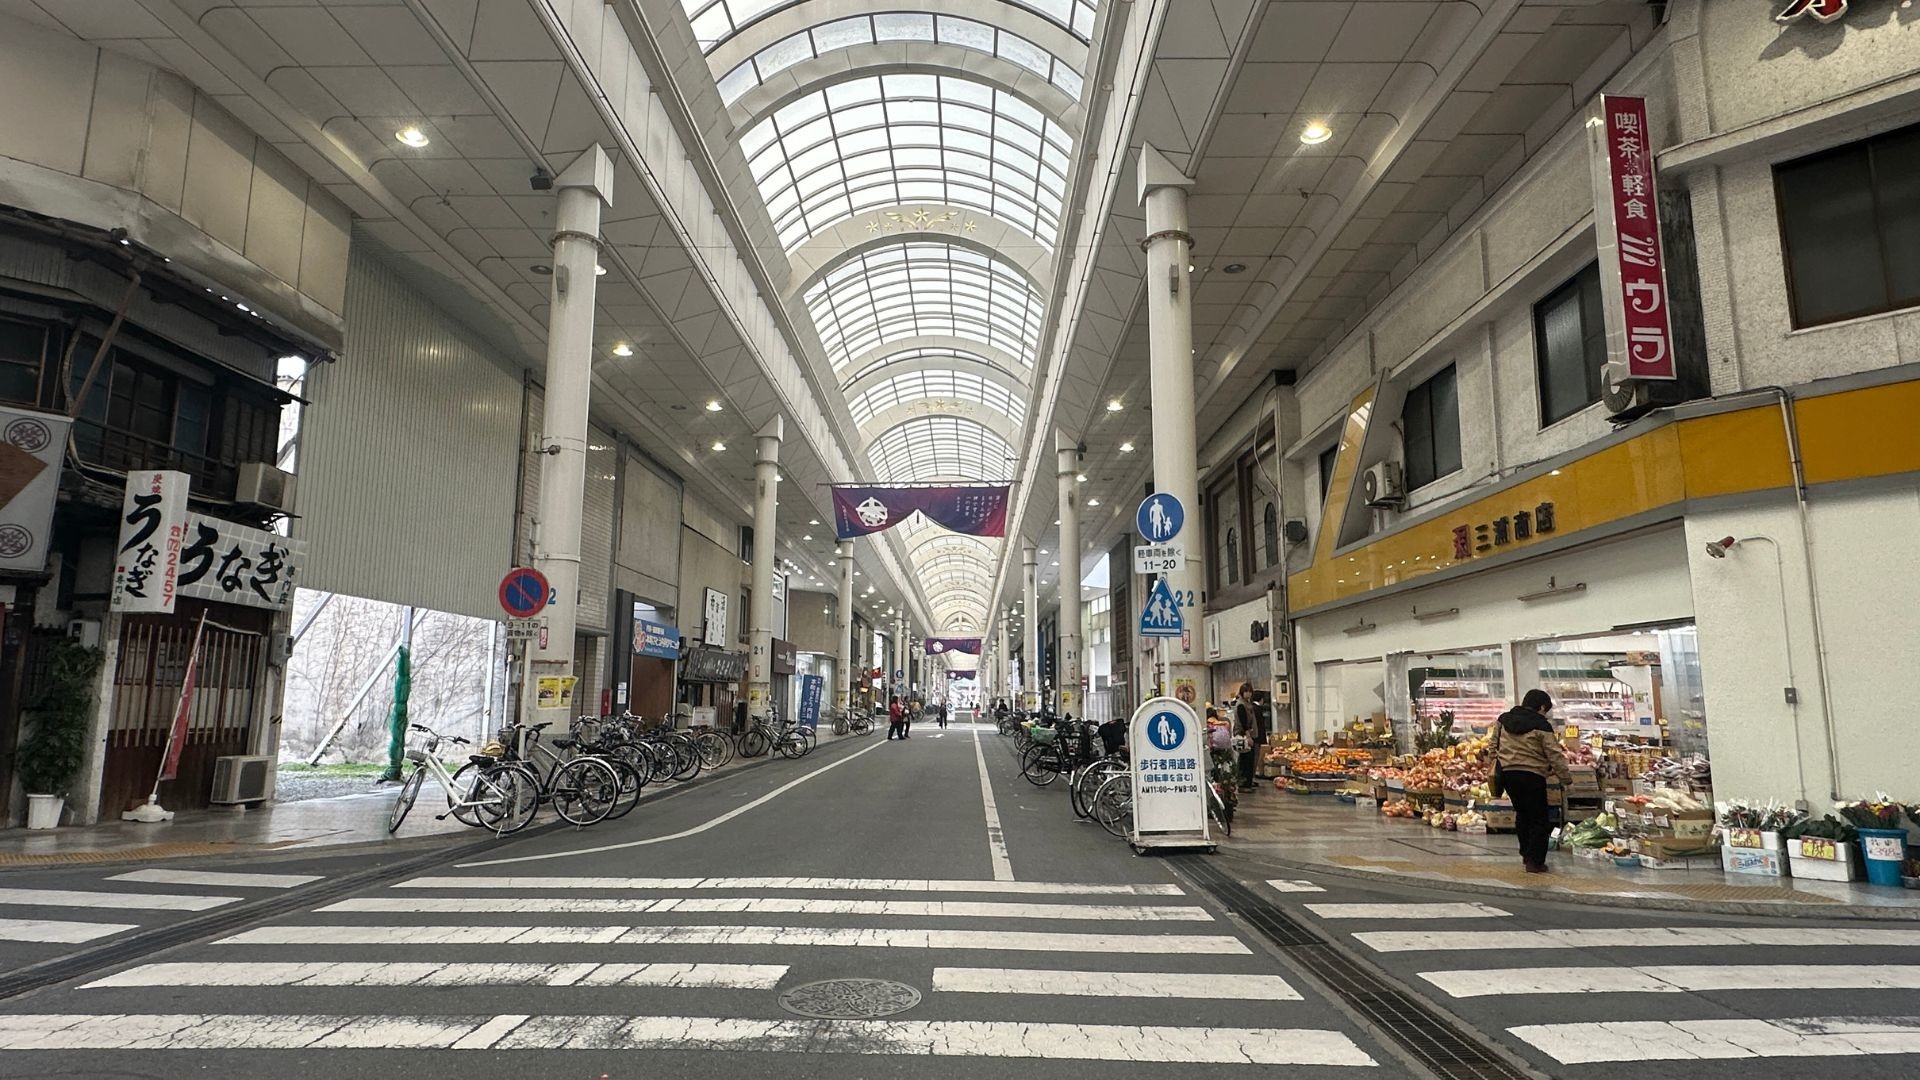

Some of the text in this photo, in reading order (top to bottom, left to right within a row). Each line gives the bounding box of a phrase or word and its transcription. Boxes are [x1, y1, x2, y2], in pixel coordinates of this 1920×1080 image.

[1614, 111, 1649, 221] 喫茶 軽食
[1620, 232, 1666, 364] ミウラ
[119, 493, 163, 599] うなぎ
[177, 521, 290, 603] うなぎ
[1143, 559, 1177, 571] 11-20
[753, 645, 764, 656] 21
[1066, 650, 1077, 660] 21
[1140, 758, 1197, 771] 歩行者用道路
[1143, 772, 1194, 783] (自転車を含む)
